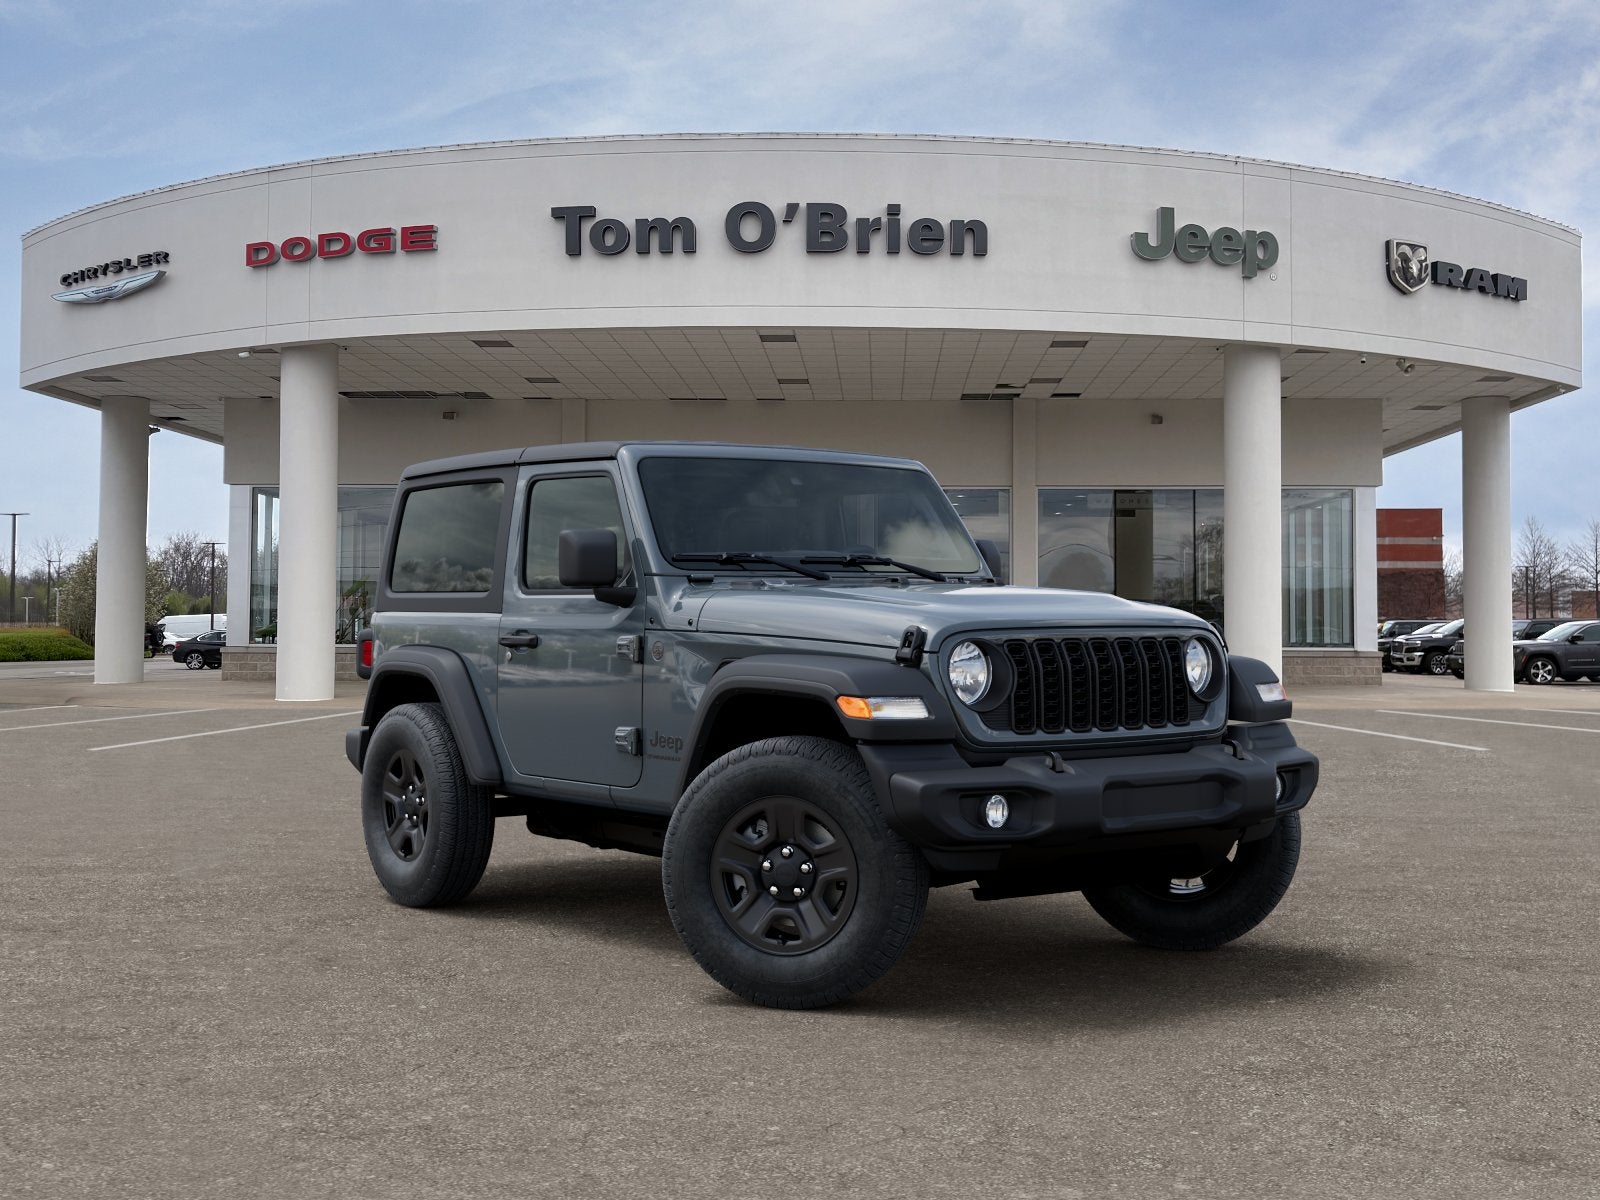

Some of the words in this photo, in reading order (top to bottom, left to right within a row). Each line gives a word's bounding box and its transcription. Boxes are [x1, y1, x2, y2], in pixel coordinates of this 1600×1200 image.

[246, 224, 438, 269] DODGE
[551, 205, 697, 256] Tom
[724, 201, 989, 256] O'Brien
[1131, 206, 1279, 279] Jeep
[60, 250, 170, 287] CHRYSLER
[1431, 260, 1528, 301] RAM
[649, 729, 684, 754] Jeep
